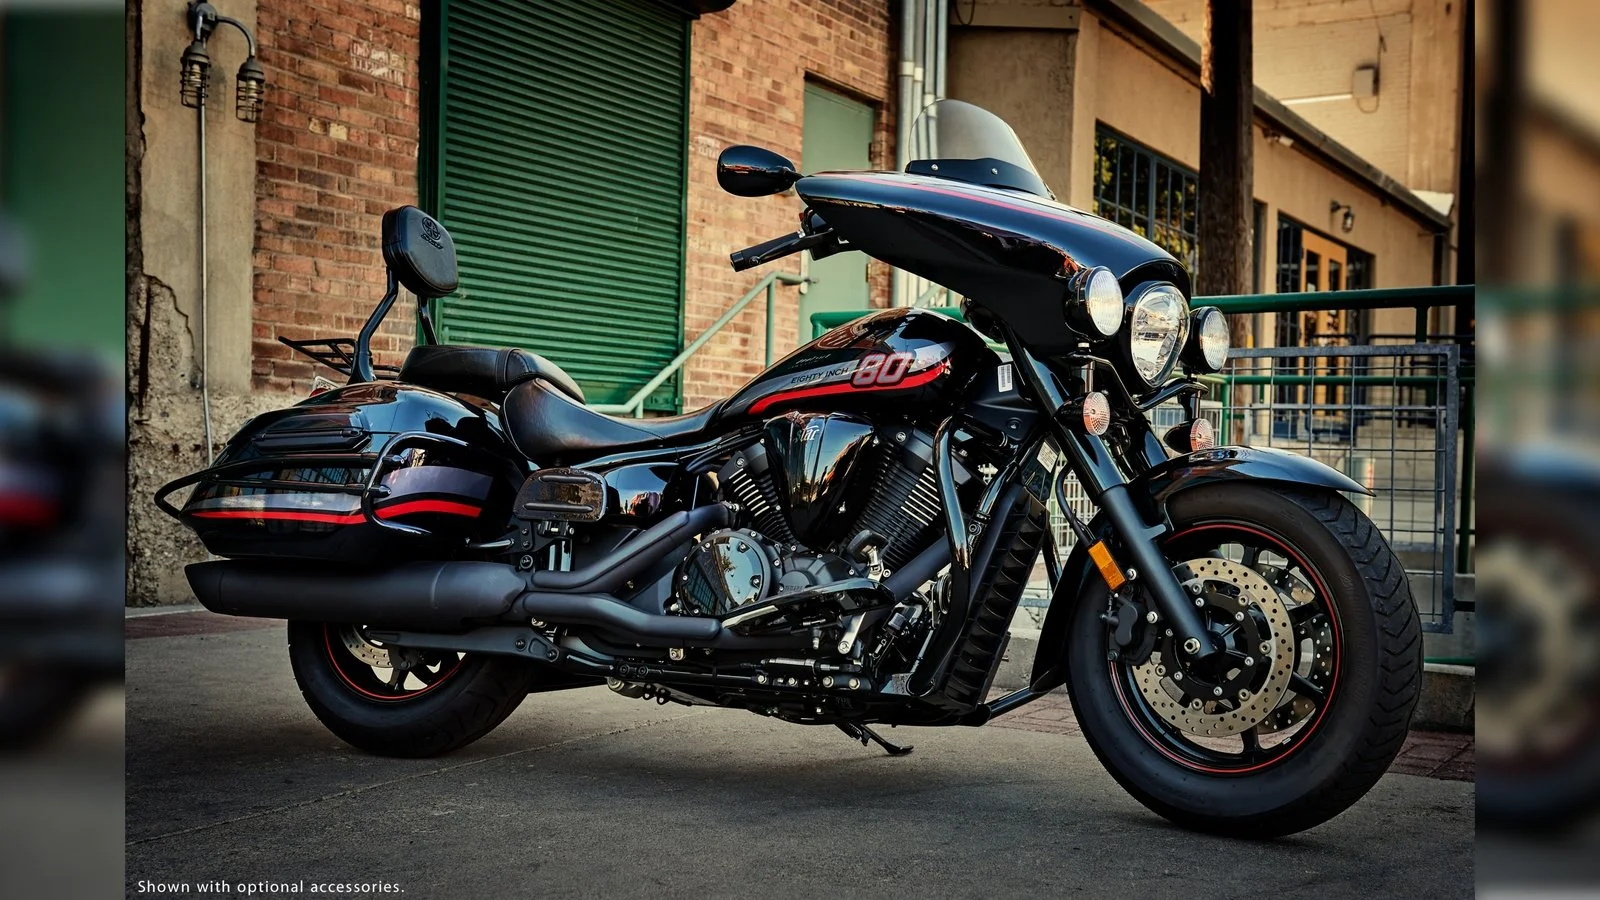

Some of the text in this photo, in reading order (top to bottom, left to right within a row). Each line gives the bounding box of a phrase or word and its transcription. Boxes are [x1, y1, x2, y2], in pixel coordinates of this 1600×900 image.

[790, 351, 914, 387] EIGHTY INCH 80
